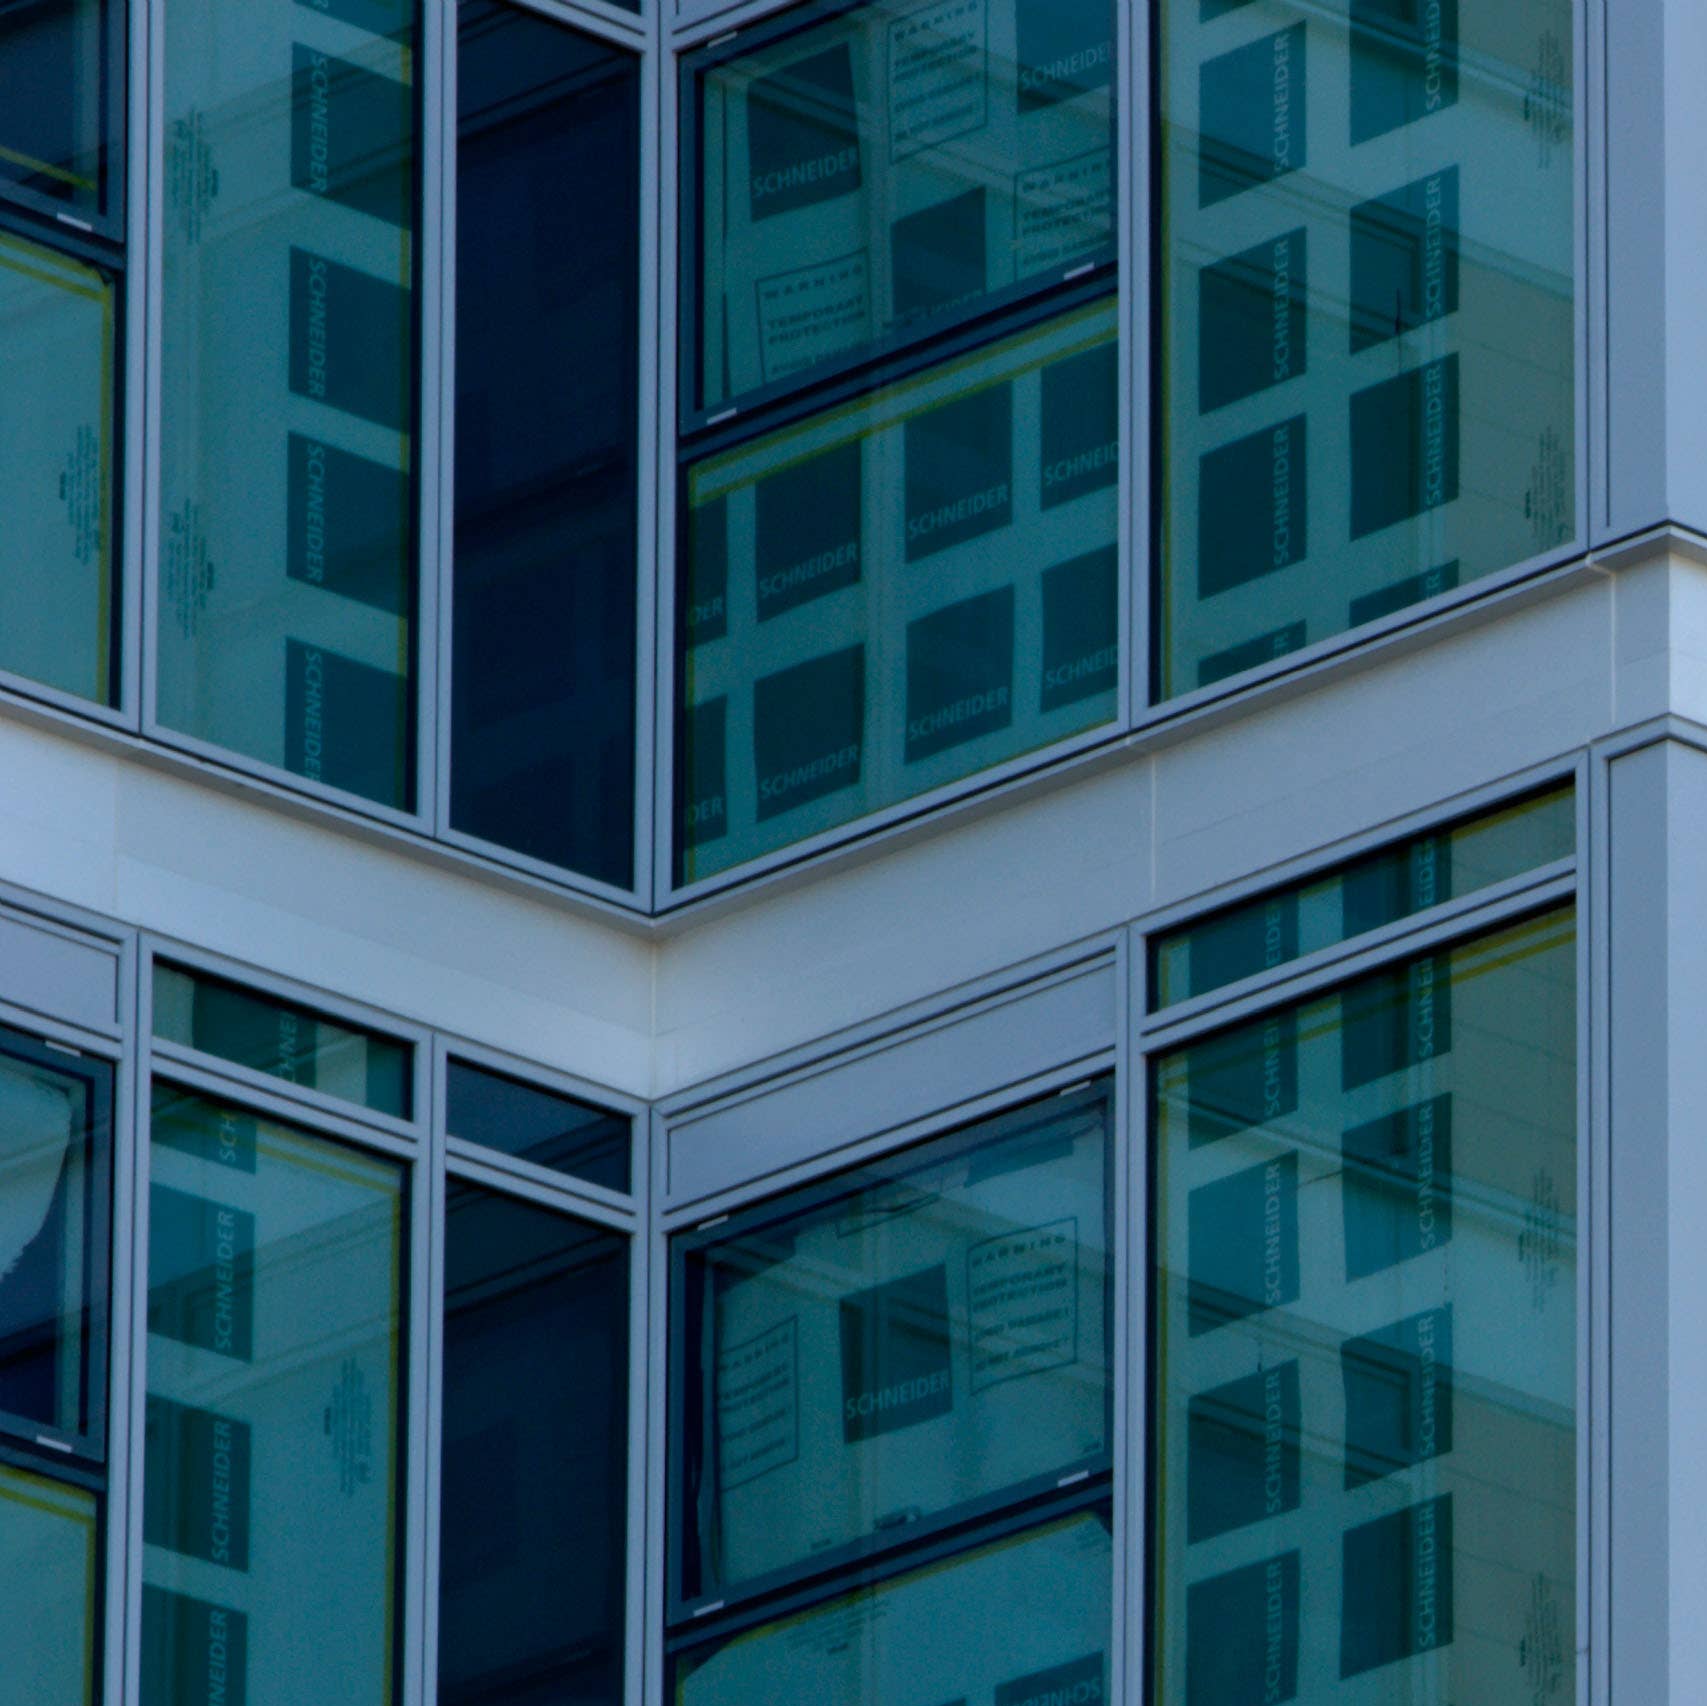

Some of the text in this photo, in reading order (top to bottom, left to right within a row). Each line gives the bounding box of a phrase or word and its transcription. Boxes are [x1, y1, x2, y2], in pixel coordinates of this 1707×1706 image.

[1272, 31, 1292, 174] SCHNEIDER
[307, 257, 330, 399] SCHNEIDER
[1272, 237, 1292, 382] SCHNEIDER
[1272, 425, 1292, 567] SCHNEIDER
[1426, 363, 1446, 506] SCHNEIDER
[305, 445, 327, 586] SCHNEIDER
[758, 540, 860, 601] SCHNEIDER
[907, 481, 1010, 542] SCHNEIDER
[760, 742, 861, 800] SCHNEIDER
[908, 685, 1011, 743] SCHNEIDER
[1264, 1162, 1283, 1306] SCHNEIDER
[1416, 1103, 1436, 1250] SCHNEIDER
[214, 1210, 236, 1351] SCHNEIDER
[1264, 1371, 1283, 1515] SCHNEIDER
[1416, 1315, 1436, 1459] SCHNEIDER
[211, 1418, 232, 1563] SCHNEIDER
[1264, 1559, 1284, 1703] SCHNEIDER
[1417, 1503, 1438, 1649] SCHNEIDER
